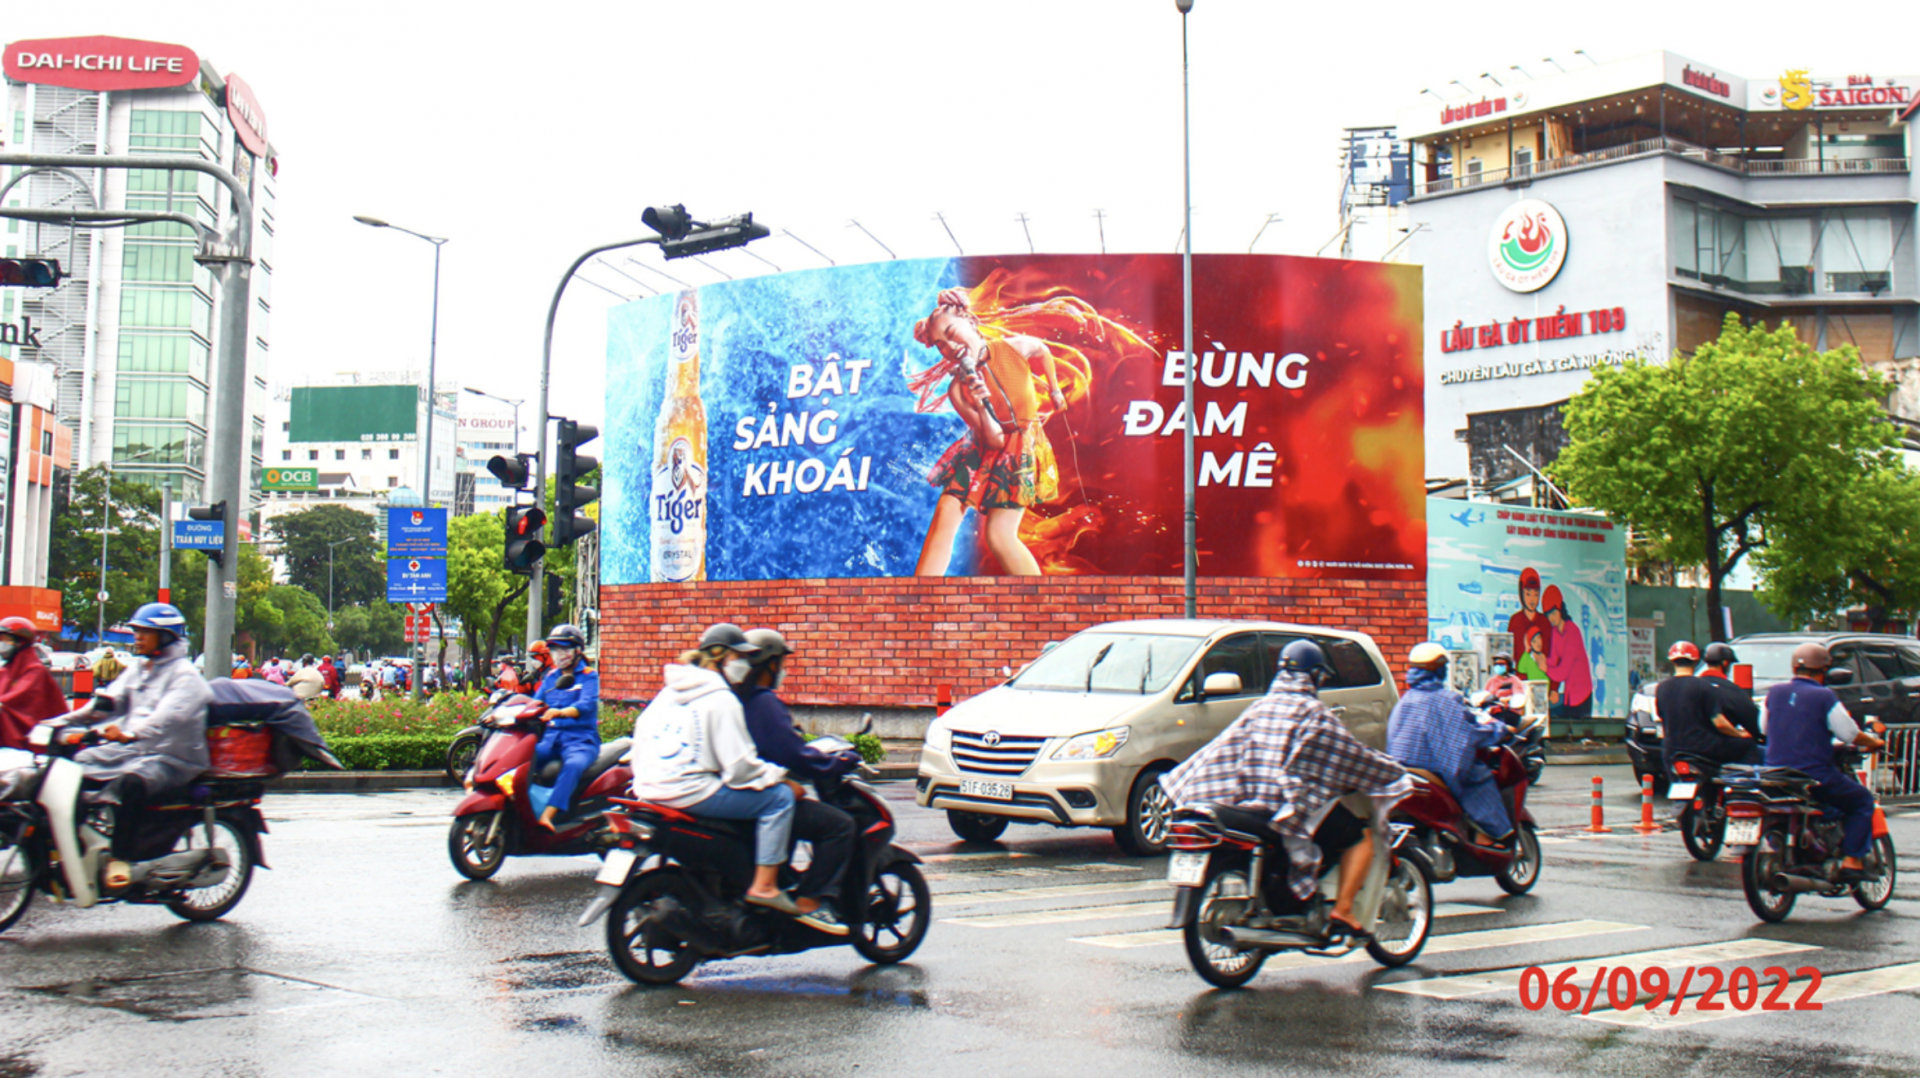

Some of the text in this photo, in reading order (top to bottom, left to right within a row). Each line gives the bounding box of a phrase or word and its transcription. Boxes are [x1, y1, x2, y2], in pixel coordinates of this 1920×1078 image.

[17, 52, 183, 73] DAI-ICHI LIFE
[1819, 87, 1903, 105] SAIGON
[672, 330, 697, 353] Tiger
[1441, 319, 1473, 354] LẨU
[1478, 318, 1503, 349] GÀ
[1536, 304, 1582, 341] HIỂM
[1588, 306, 1625, 334] 109
[787, 352, 872, 406] BẬT
[1162, 341, 1310, 389] BÙNG
[1522, 358, 1544, 376] GÀ
[1545, 359, 1556, 373] &
[1558, 354, 1580, 371] GÀ
[470, 418, 515, 429] GROUP
[733, 402, 840, 450] SẢNG
[1122, 400, 1248, 437] ĐAM
[281, 471, 311, 483] OCB
[742, 447, 872, 497] KHOÁI
[1198, 442, 1277, 487] MÊ
[655, 489, 702, 534] Tiger
[663, 550, 692, 559] CRYSTAL
